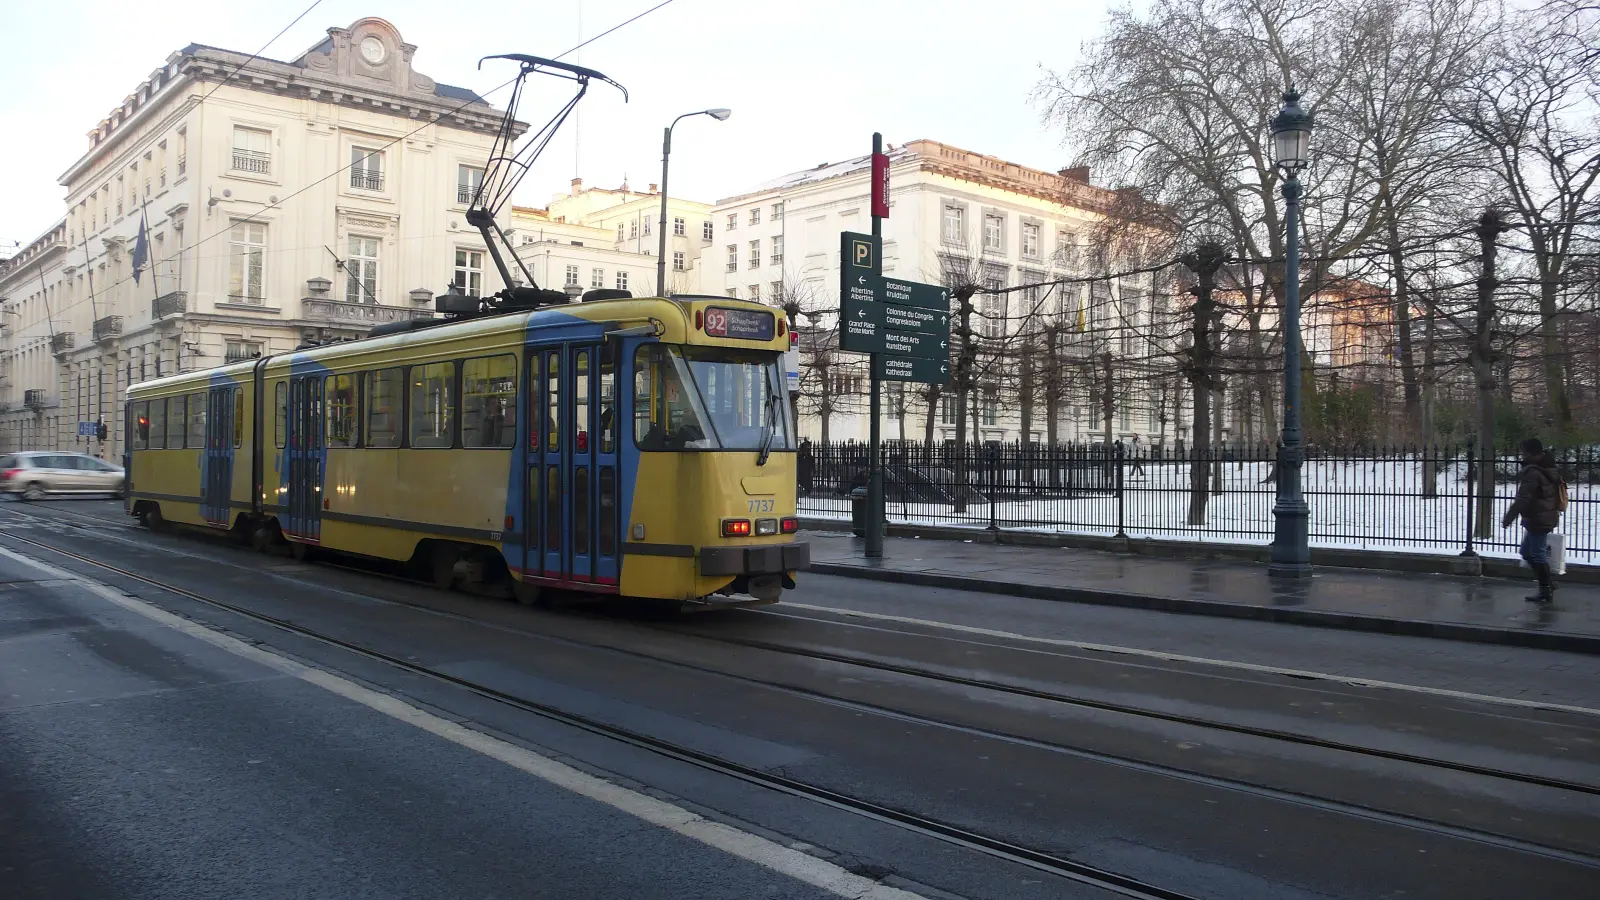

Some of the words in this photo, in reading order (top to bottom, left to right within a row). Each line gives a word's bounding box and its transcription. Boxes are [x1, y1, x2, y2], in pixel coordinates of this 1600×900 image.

[857, 244, 868, 263] P
[851, 286, 874, 296] Albertine
[886, 281, 912, 292] Botanique
[886, 290, 910, 300] Kruidtuin
[886, 307, 907, 316] Colonne
[707, 314, 725, 331] 92
[886, 316, 921, 327] Congreskolom
[885, 333, 900, 342] Mont
[909, 336, 920, 345] Arts
[885, 342, 912, 352] Kunstberg
[747, 499, 775, 513] 7737
